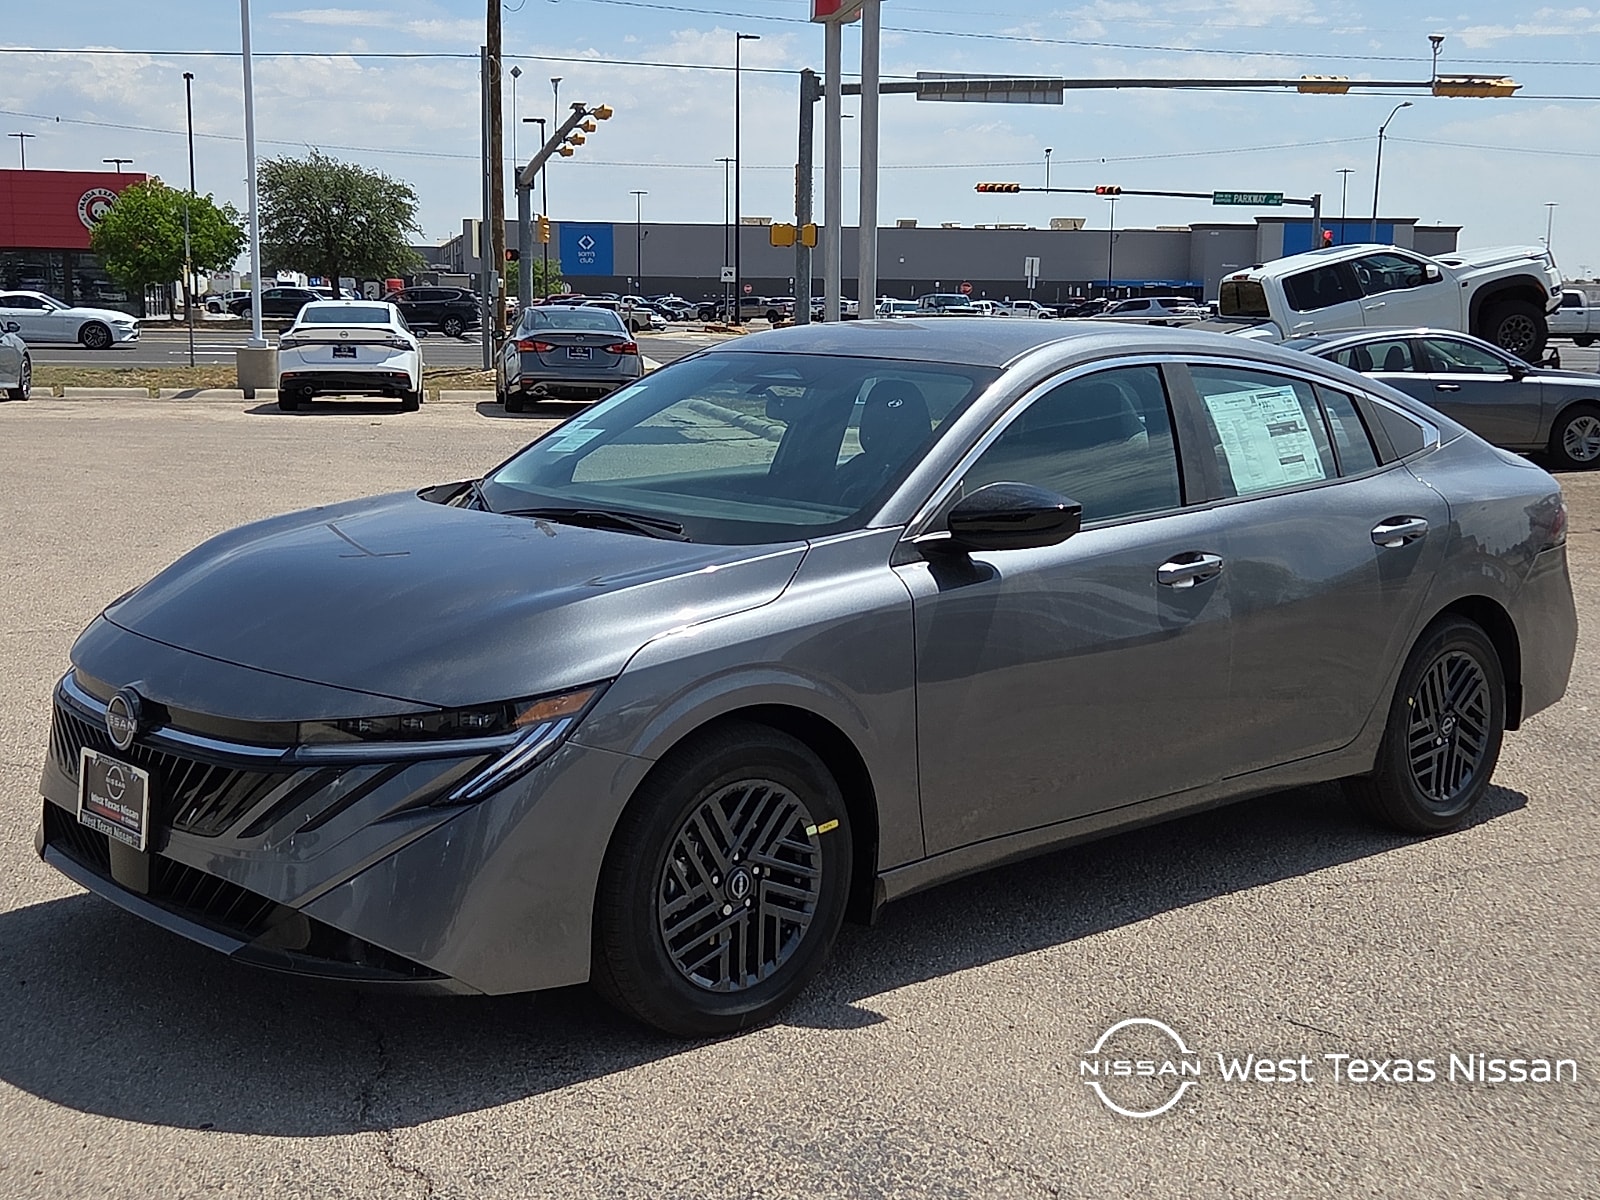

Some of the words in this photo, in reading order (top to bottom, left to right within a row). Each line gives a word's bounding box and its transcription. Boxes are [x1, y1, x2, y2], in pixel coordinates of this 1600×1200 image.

[79, 191, 97, 211] PANDA
[1233, 194, 1267, 204] PARKWAY
[105, 776, 126, 789] NISSAN
[90, 791, 105, 806] West
[104, 797, 121, 812] Texas
[121, 803, 139, 820] Nissan
[81, 811, 97, 828] West
[97, 818, 113, 834] Texas
[113, 825, 133, 845] Nissan
